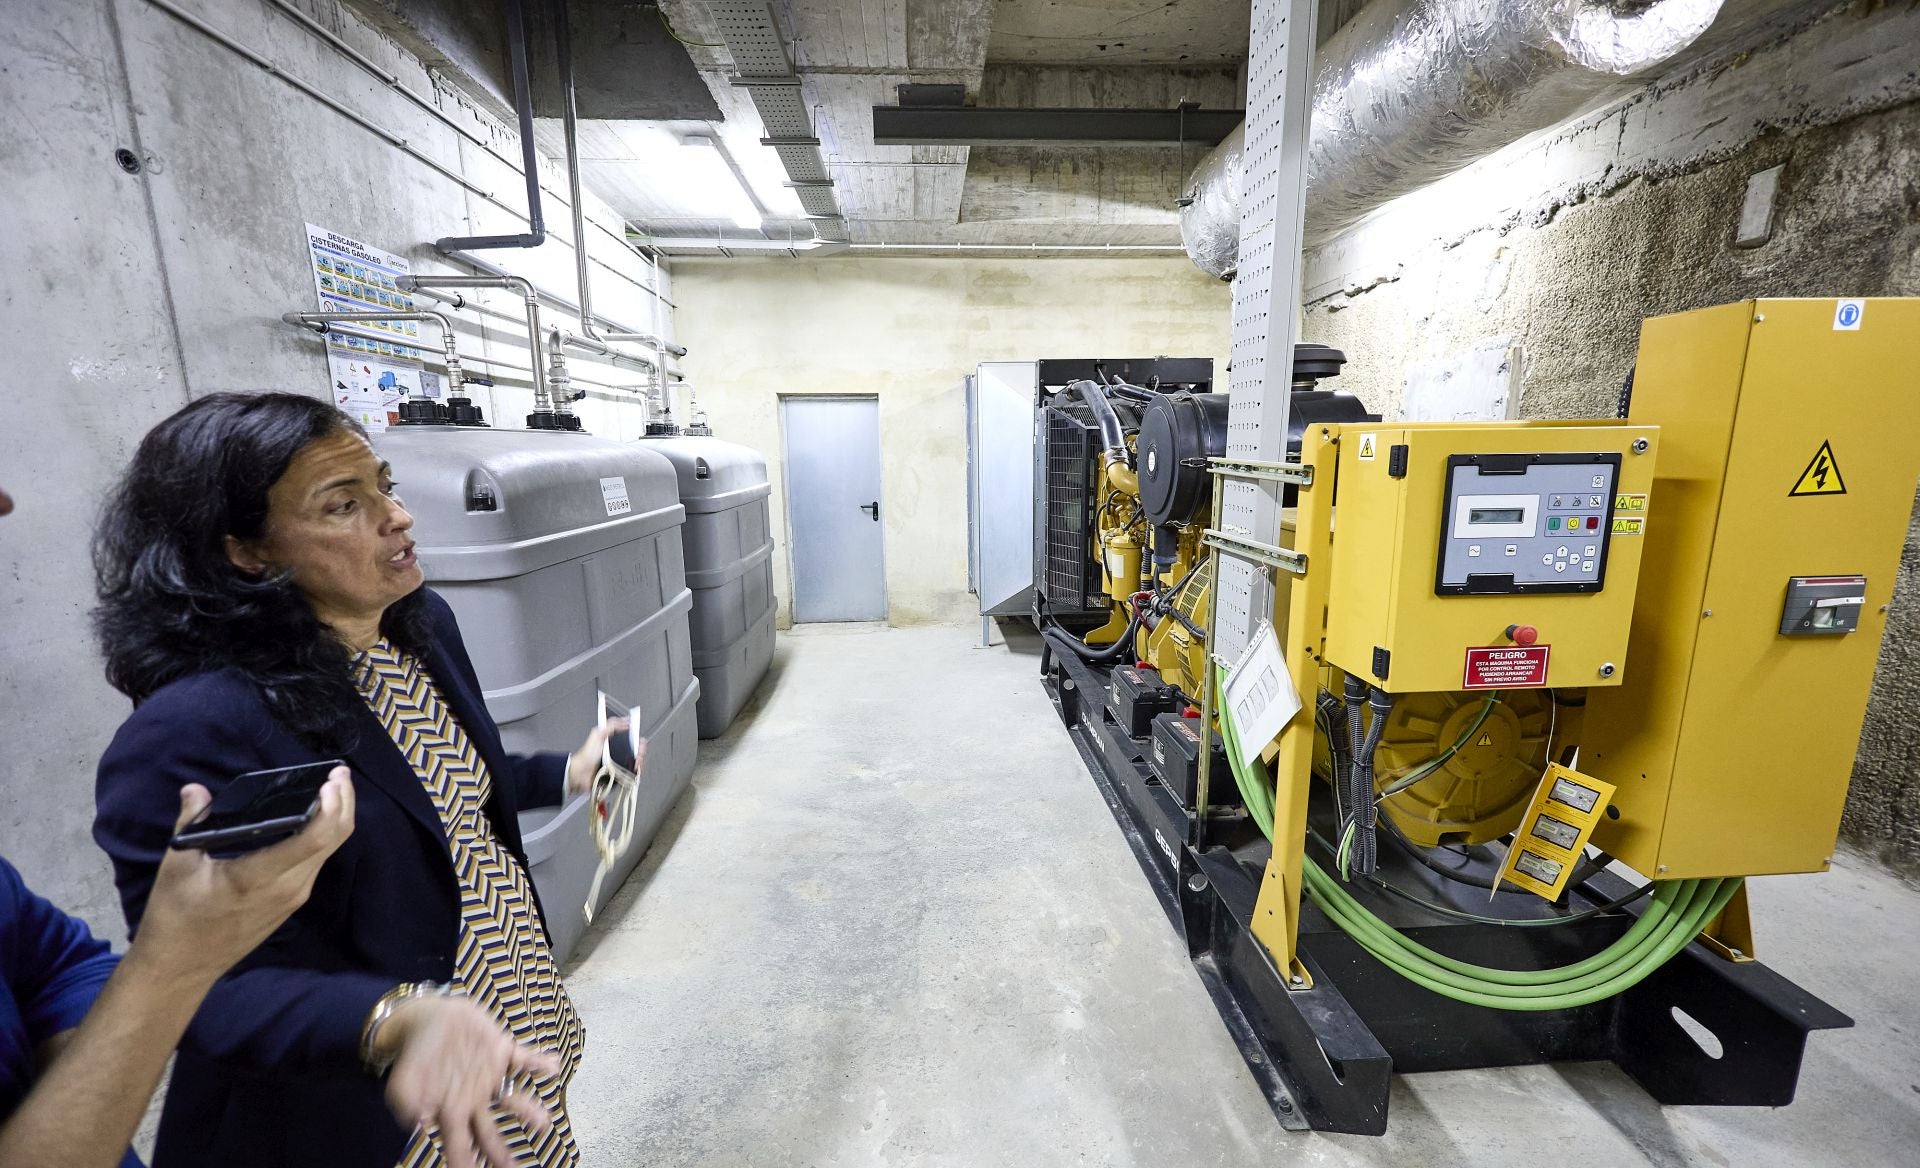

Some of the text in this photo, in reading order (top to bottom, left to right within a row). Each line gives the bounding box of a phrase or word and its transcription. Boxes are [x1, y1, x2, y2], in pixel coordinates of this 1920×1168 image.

[311, 235, 350, 254] CISTERNAS
[328, 233, 364, 251] DESCARGA
[1489, 652, 1526, 660] PELIGRO
